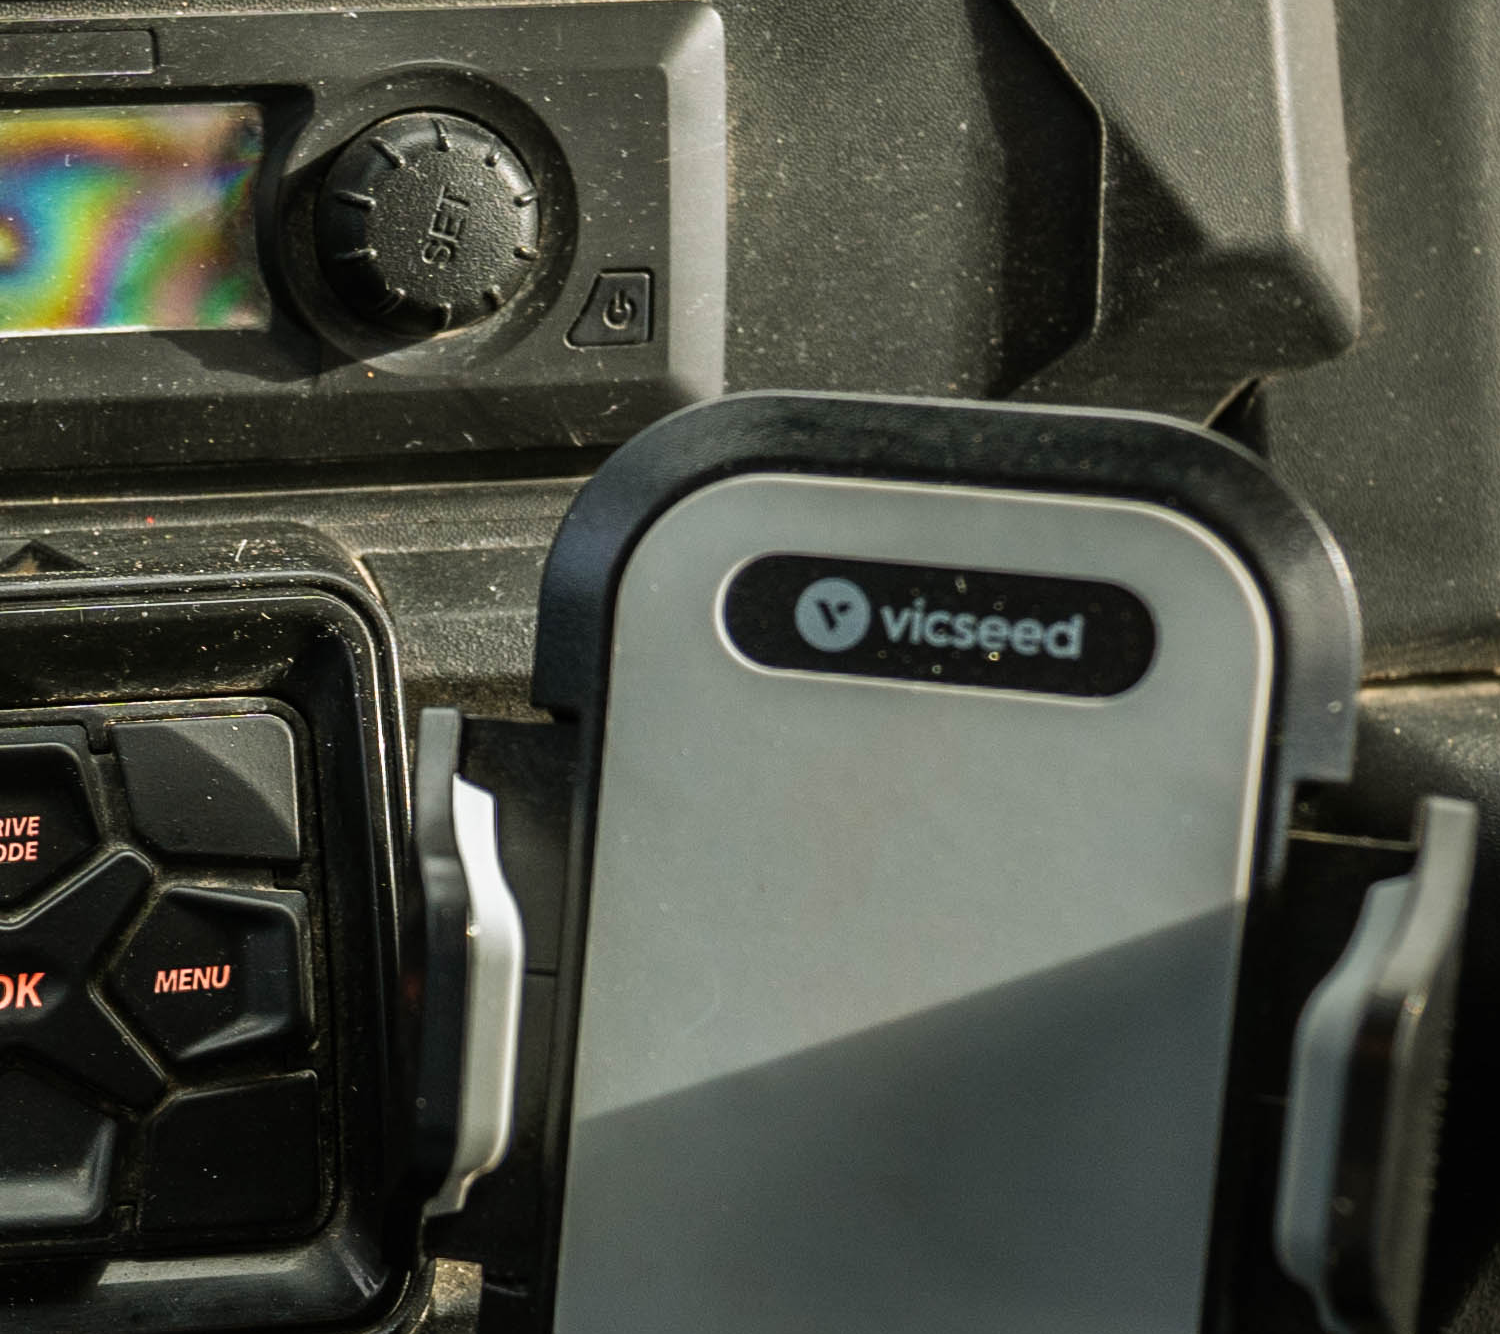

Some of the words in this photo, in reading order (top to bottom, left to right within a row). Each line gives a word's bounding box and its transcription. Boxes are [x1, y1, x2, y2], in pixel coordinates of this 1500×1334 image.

[421, 185, 470, 265] SET
[879, 596, 1085, 660] vicseed
[153, 965, 231, 994] MENU
